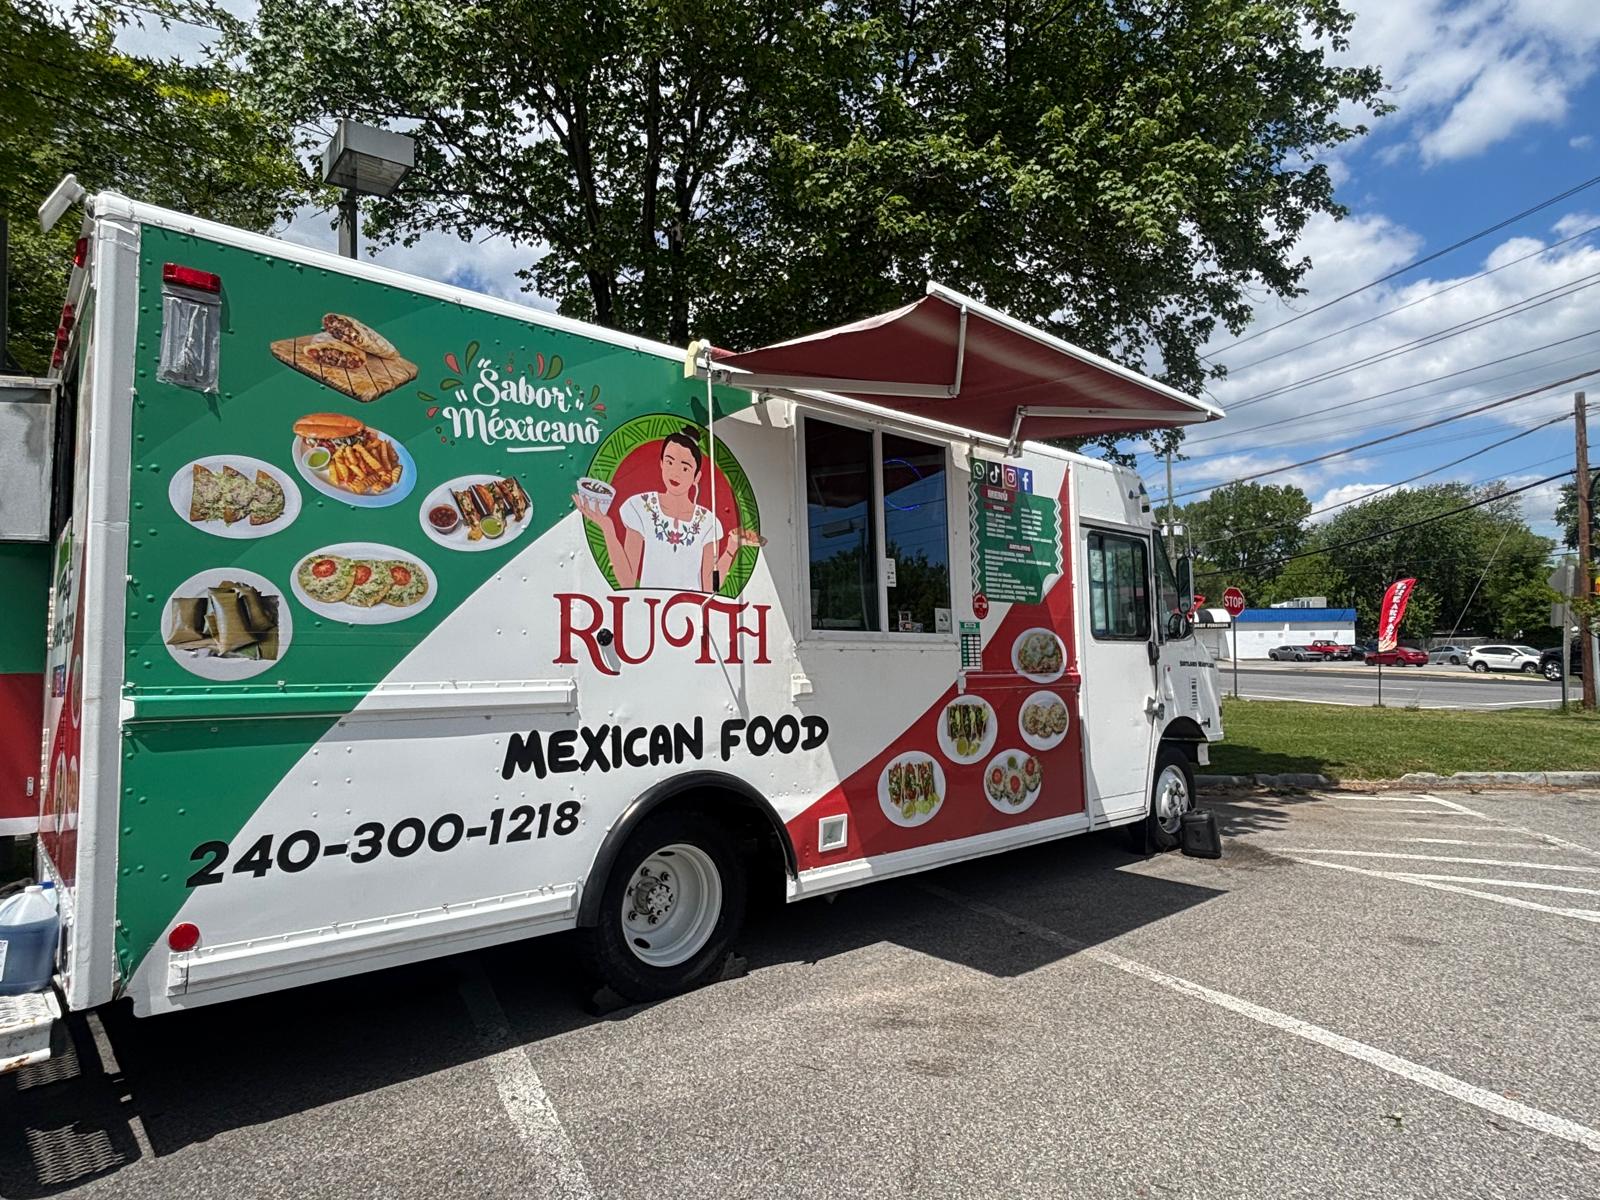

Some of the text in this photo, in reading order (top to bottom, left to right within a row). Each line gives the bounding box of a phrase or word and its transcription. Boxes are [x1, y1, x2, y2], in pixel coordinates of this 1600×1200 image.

[473, 368, 571, 413] Sabor
[552, 592, 772, 676] RUTH
[1224, 595, 1243, 608] STOP
[501, 715, 830, 780] MEXICAN FOOD
[185, 800, 581, 887] 240-300-1218
